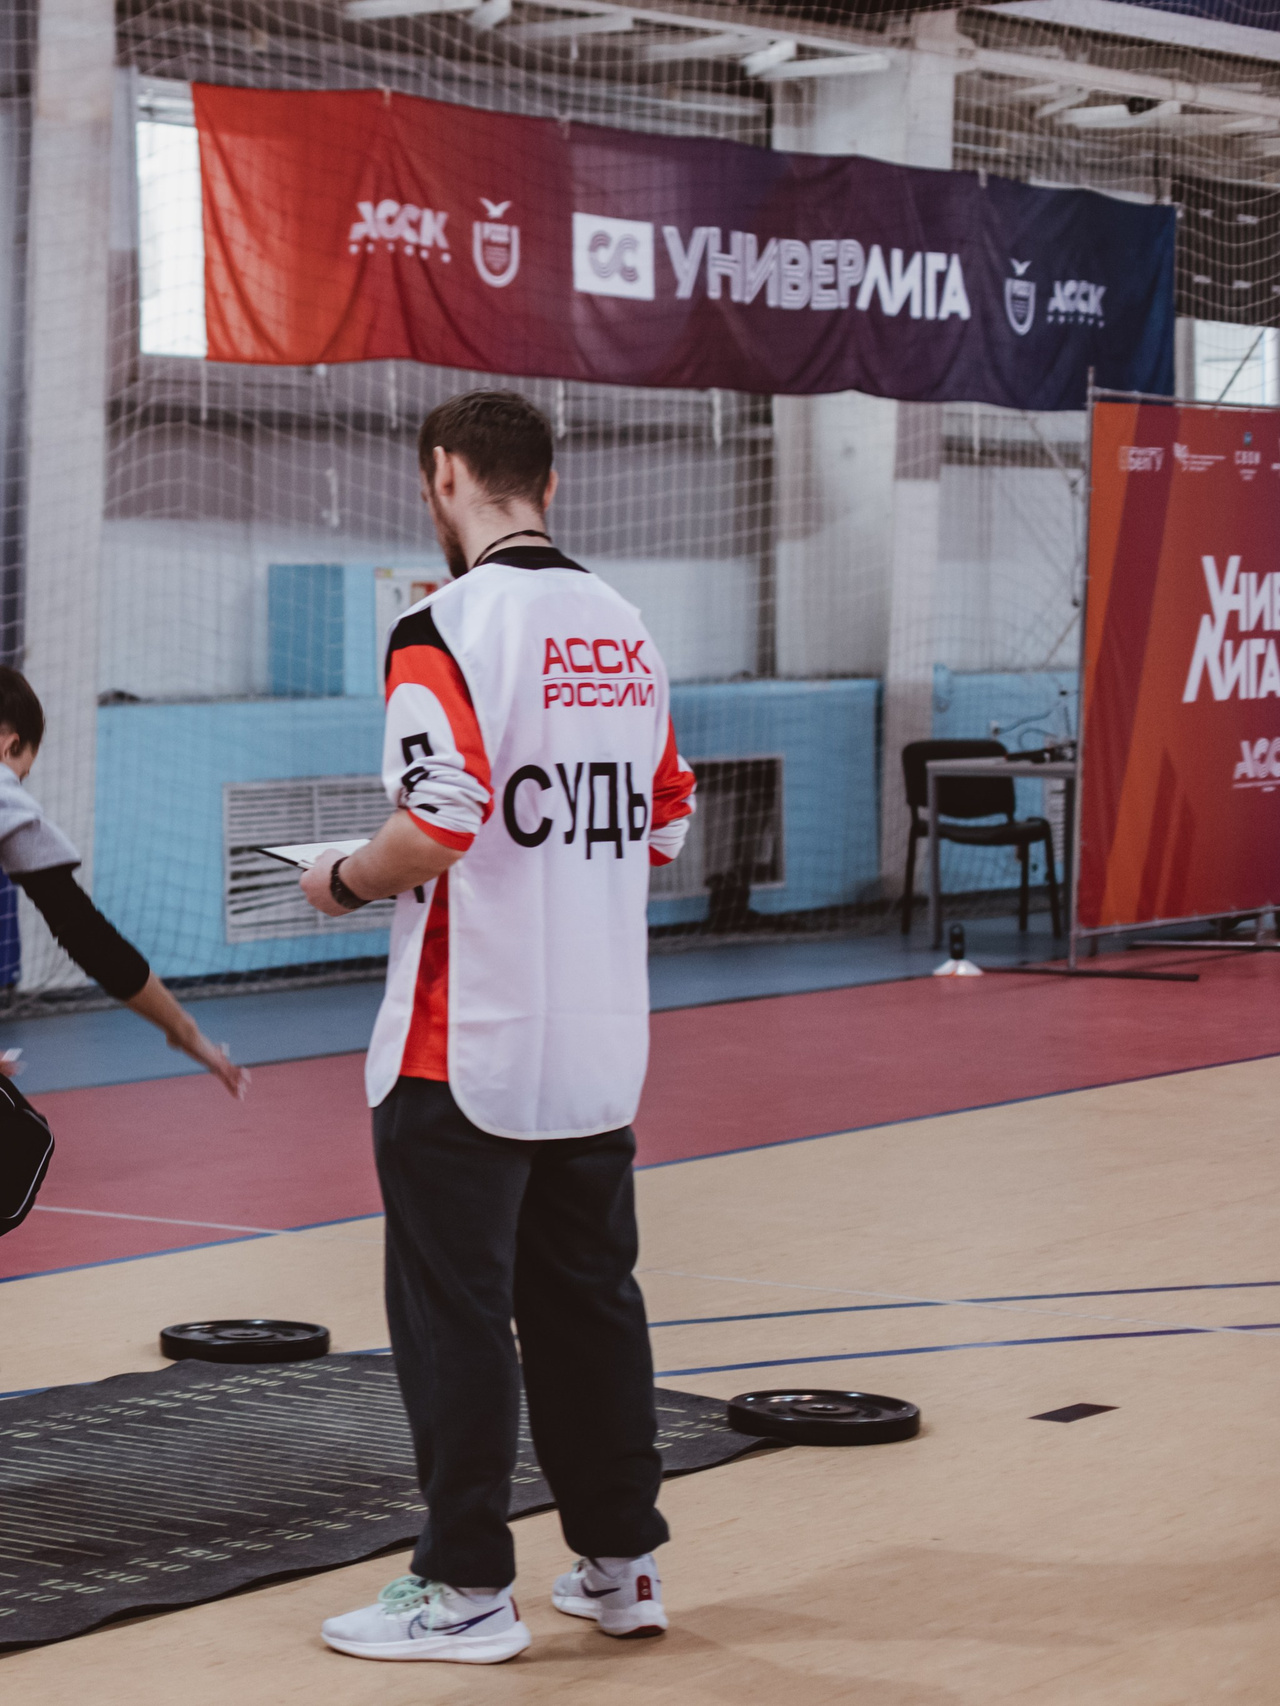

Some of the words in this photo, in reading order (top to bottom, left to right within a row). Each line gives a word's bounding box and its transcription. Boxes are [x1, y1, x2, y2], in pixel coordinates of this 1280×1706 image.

[349, 199, 449, 249] АССК
[662, 226, 971, 320] УНИВЕРЛИГА
[542, 637, 652, 675] АССК
[543, 682, 655, 709] РОССИИ
[502, 762, 648, 860] СУДЬ
[248, 1527, 314, 1541] 170
[209, 1537, 274, 1551] 160
[167, 1547, 233, 1561] 150
[125, 1557, 191, 1572] 140
[82, 1568, 149, 1583] 130
[38, 1579, 106, 1594] 120
